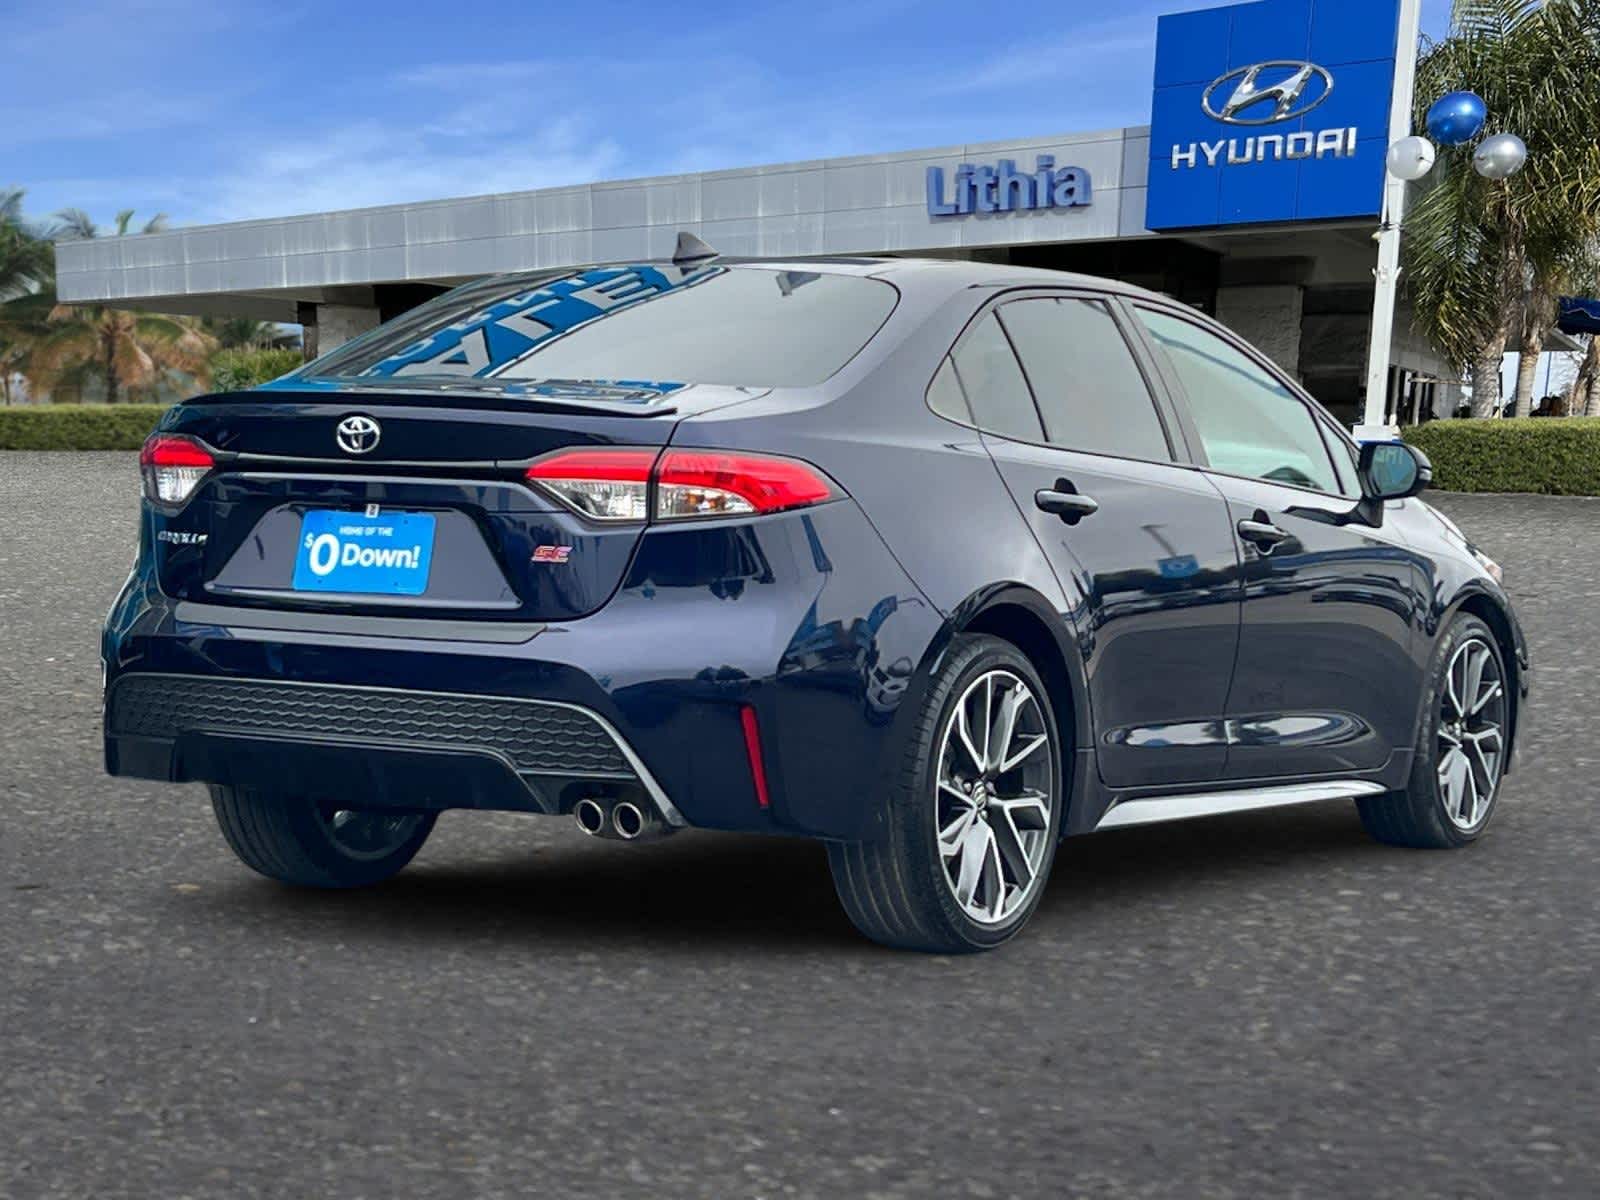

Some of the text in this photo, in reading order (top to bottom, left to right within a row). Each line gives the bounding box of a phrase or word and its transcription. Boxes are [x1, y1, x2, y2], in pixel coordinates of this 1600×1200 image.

[1171, 127, 1357, 169] HYUNDAI
[926, 155, 1093, 217] Lithia
[339, 526, 394, 537] HOME OF THE
[341, 543, 421, 569] Down!
[531, 545, 573, 563] SE
